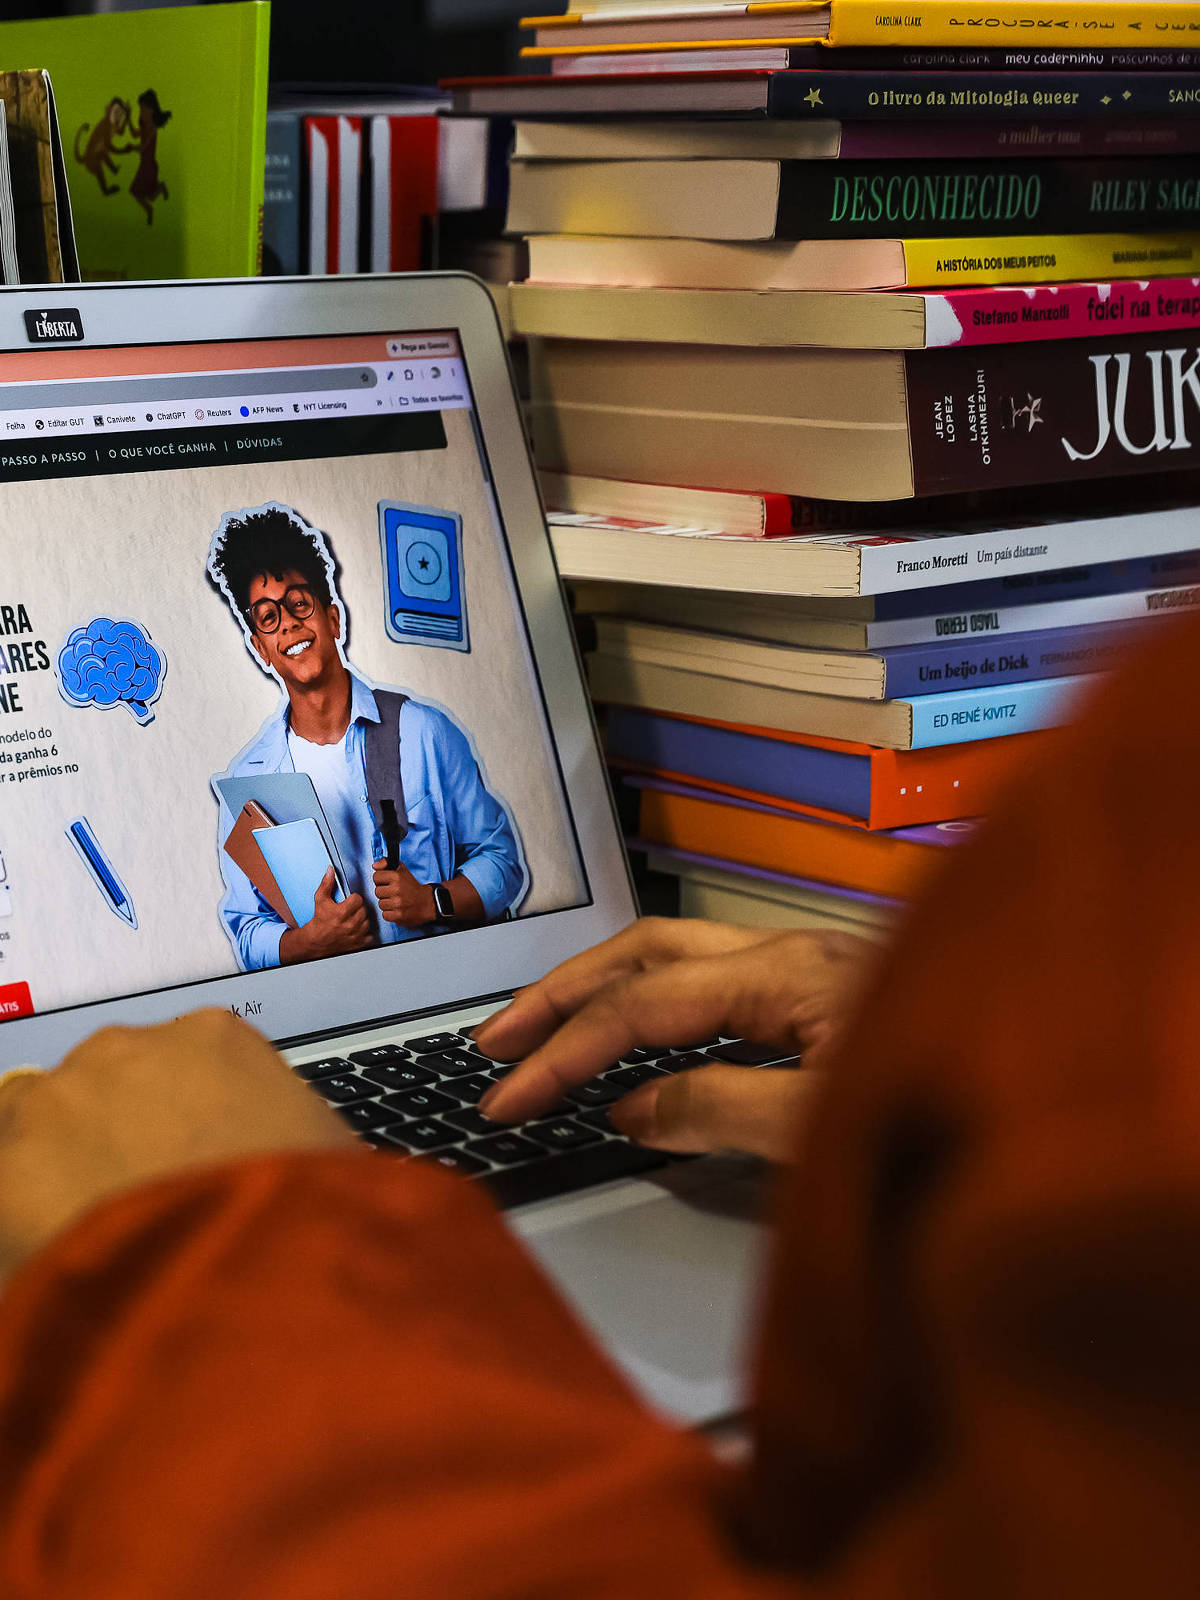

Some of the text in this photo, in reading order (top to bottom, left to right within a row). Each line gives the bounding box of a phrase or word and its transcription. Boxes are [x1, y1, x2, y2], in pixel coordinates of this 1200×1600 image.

[875, 15, 922, 26] CAROLINA CLARK
[949, 17, 1115, 30] PROCURA-SE
[903, 53, 991, 65] carolina clark
[1005, 54, 1031, 64] meu
[1111, 54, 1173, 65] rascunhos
[868, 90, 1080, 107] O livro da Mitologia Queer
[830, 174, 1042, 222] DESCONHECIDO
[1089, 178, 1151, 213] RILEY
[944, 254, 1056, 271] HISTÓRIA DOS MEUS PEITOS
[973, 309, 1018, 326] Stefano
[1130, 299, 1151, 317] na
[1062, 347, 1200, 461] JUK
[6, 421, 26, 431] Folha
[47, 418, 68, 428] Editar
[69, 417, 85, 427] GUT
[106, 414, 136, 424] Canivete
[156, 411, 187, 421] ChatGPT
[207, 408, 232, 417] Reuters
[252, 406, 265, 414] AFP
[266, 405, 284, 413] News
[303, 402, 316, 411] NYT
[317, 401, 347, 410] Licensing
[934, 401, 944, 439] JEAN
[945, 395, 955, 443] LOPEZ
[968, 394, 978, 442] LASHA
[977, 369, 991, 465] OTKHMEZURI
[1, 454, 37, 467] PASSO
[51, 451, 87, 463] PASSO
[108, 449, 117, 459] O
[120, 447, 144, 459] QUE
[145, 443, 175, 456] VOCÊ
[178, 442, 217, 454] GANHA
[236, 437, 284, 450] DÚVIDAS
[896, 545, 1048, 573] Franco Moretti Um país distante
[935, 612, 1000, 636] TIAGO FERRO
[919, 654, 1029, 681] Um beijo de Dick
[933, 704, 1017, 728] ED RENÉ KIVITZ
[38, 727, 52, 739] do
[15, 746, 49, 763] ganha
[50, 744, 59, 756] 6
[17, 764, 63, 783] prêmios
[64, 763, 79, 774] no
[0, 931, 11, 941] os
[245, 1000, 263, 1016] Air
